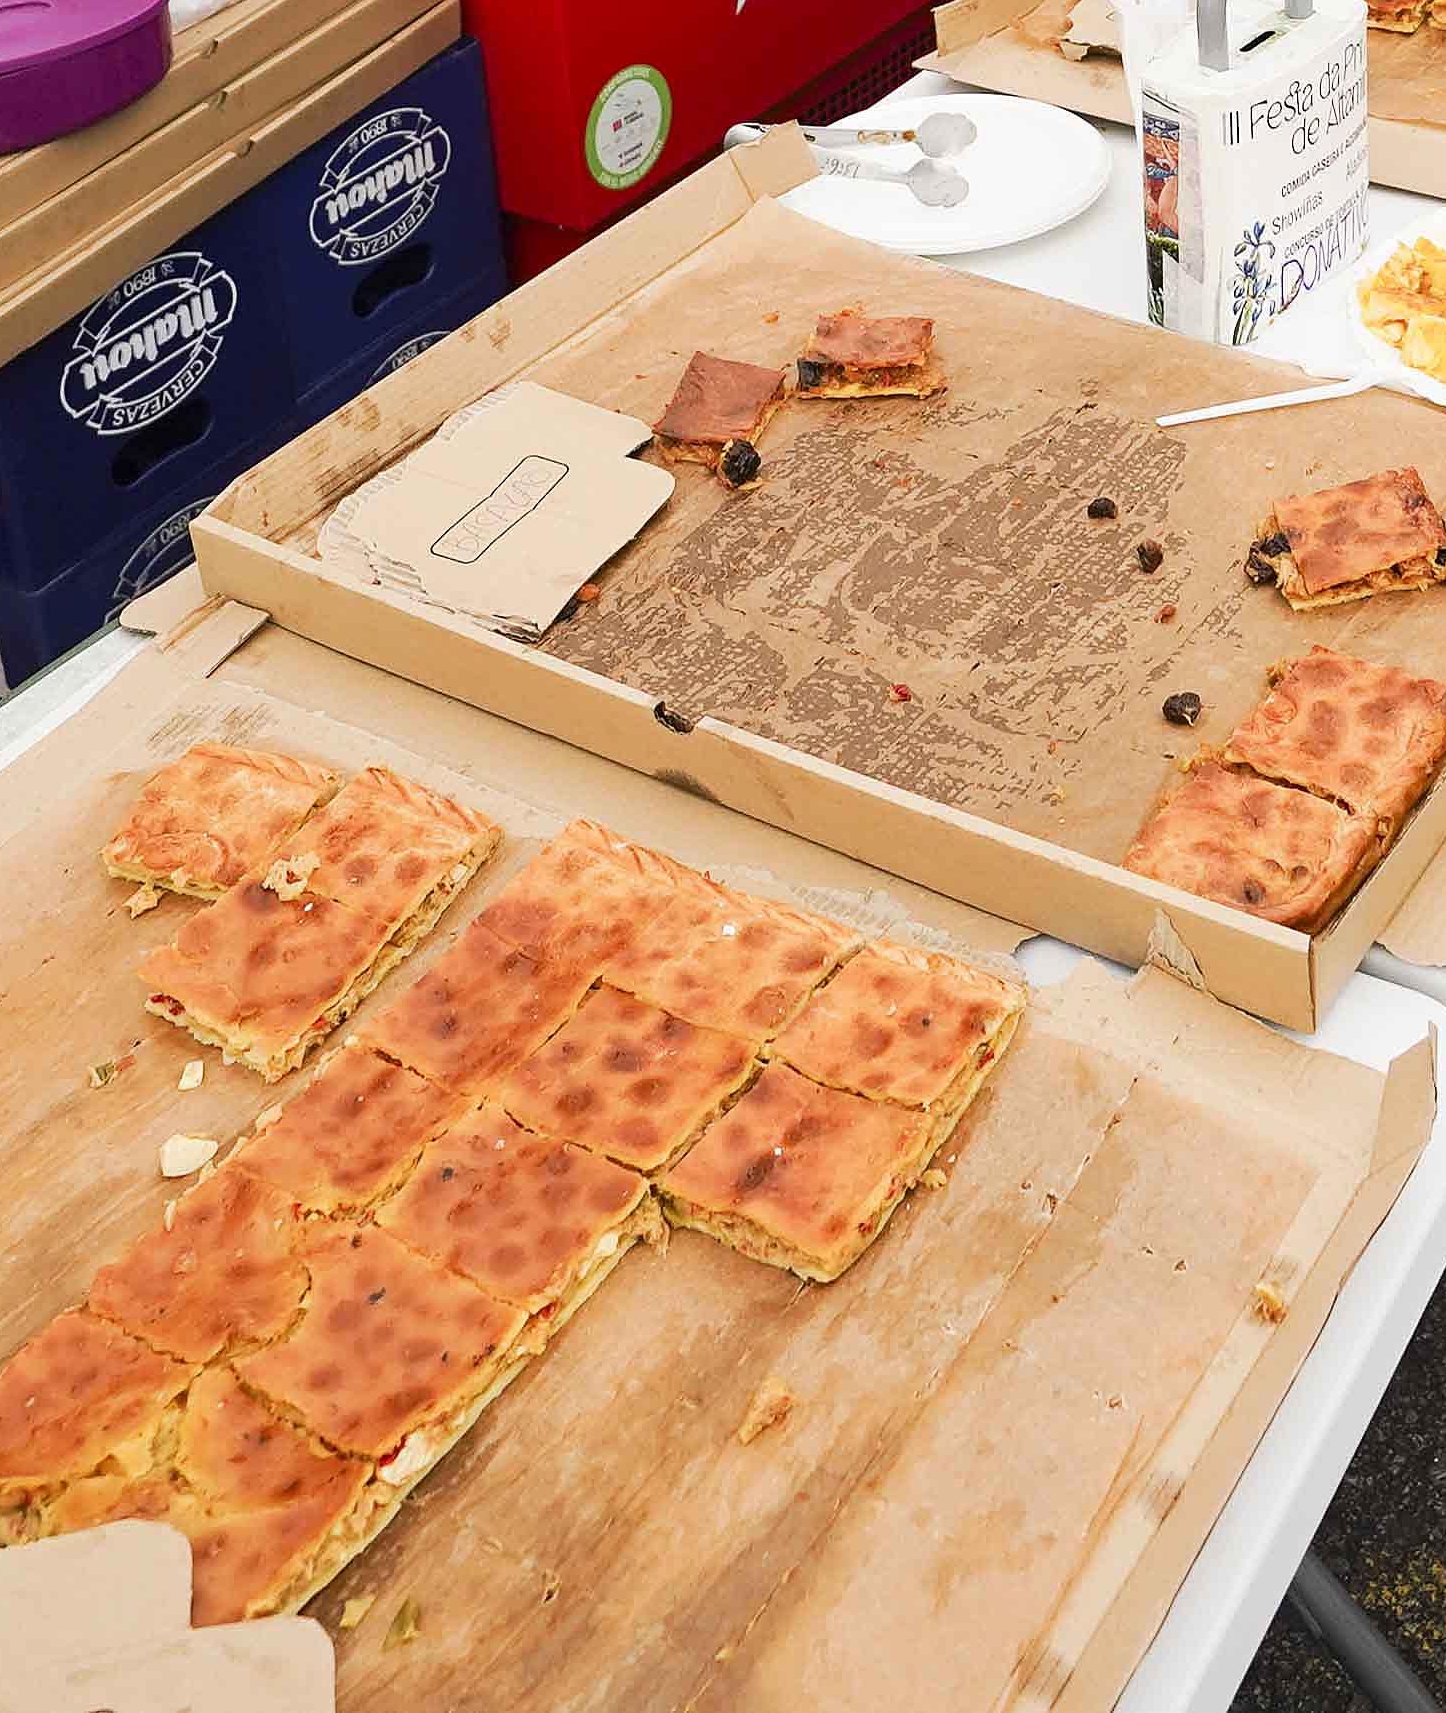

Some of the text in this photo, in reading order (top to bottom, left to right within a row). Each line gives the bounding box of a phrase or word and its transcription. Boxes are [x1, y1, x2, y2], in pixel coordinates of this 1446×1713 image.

[359, 118, 389, 145] 1890
[1250, 80, 1313, 139] Festa
[1319, 62, 1340, 99] da
[1291, 118, 1320, 155] de
[325, 140, 437, 225] Mahou
[350, 203, 425, 258] CERVEZAS
[122, 266, 157, 298] 1890
[78, 286, 219, 391] Mahou
[112, 358, 205, 427] CERVEZAS
